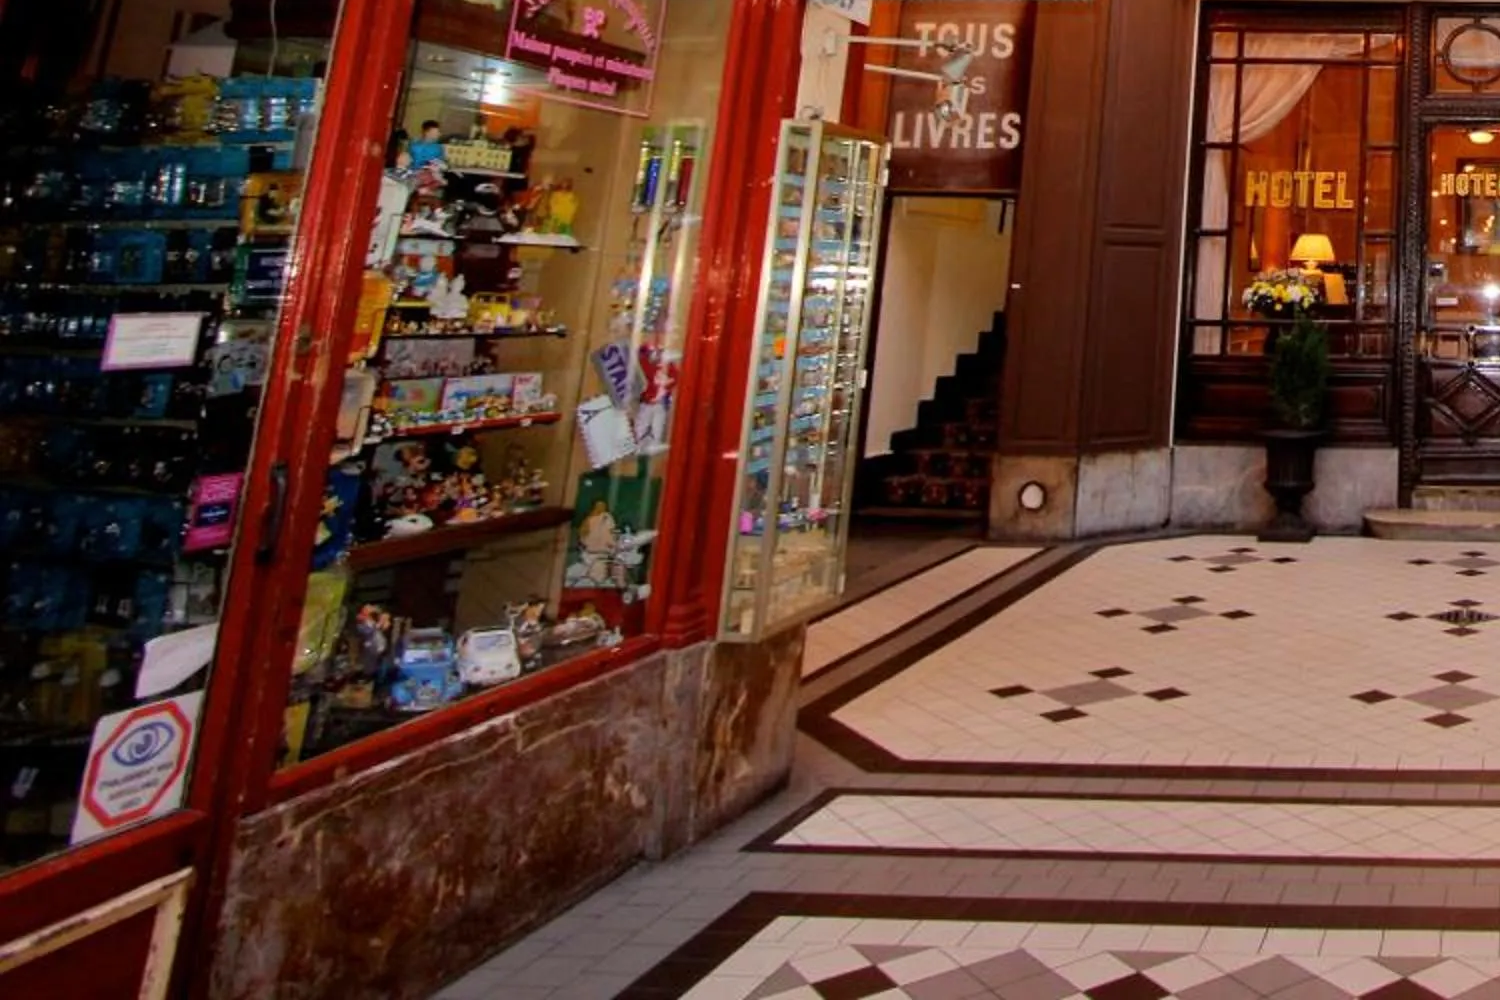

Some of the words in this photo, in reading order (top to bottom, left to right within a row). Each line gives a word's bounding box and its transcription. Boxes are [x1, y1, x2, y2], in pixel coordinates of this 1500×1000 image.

[914, 22, 1016, 59] TOUS
[893, 111, 1022, 149] LIVRES
[1245, 170, 1355, 210] HOTEL
